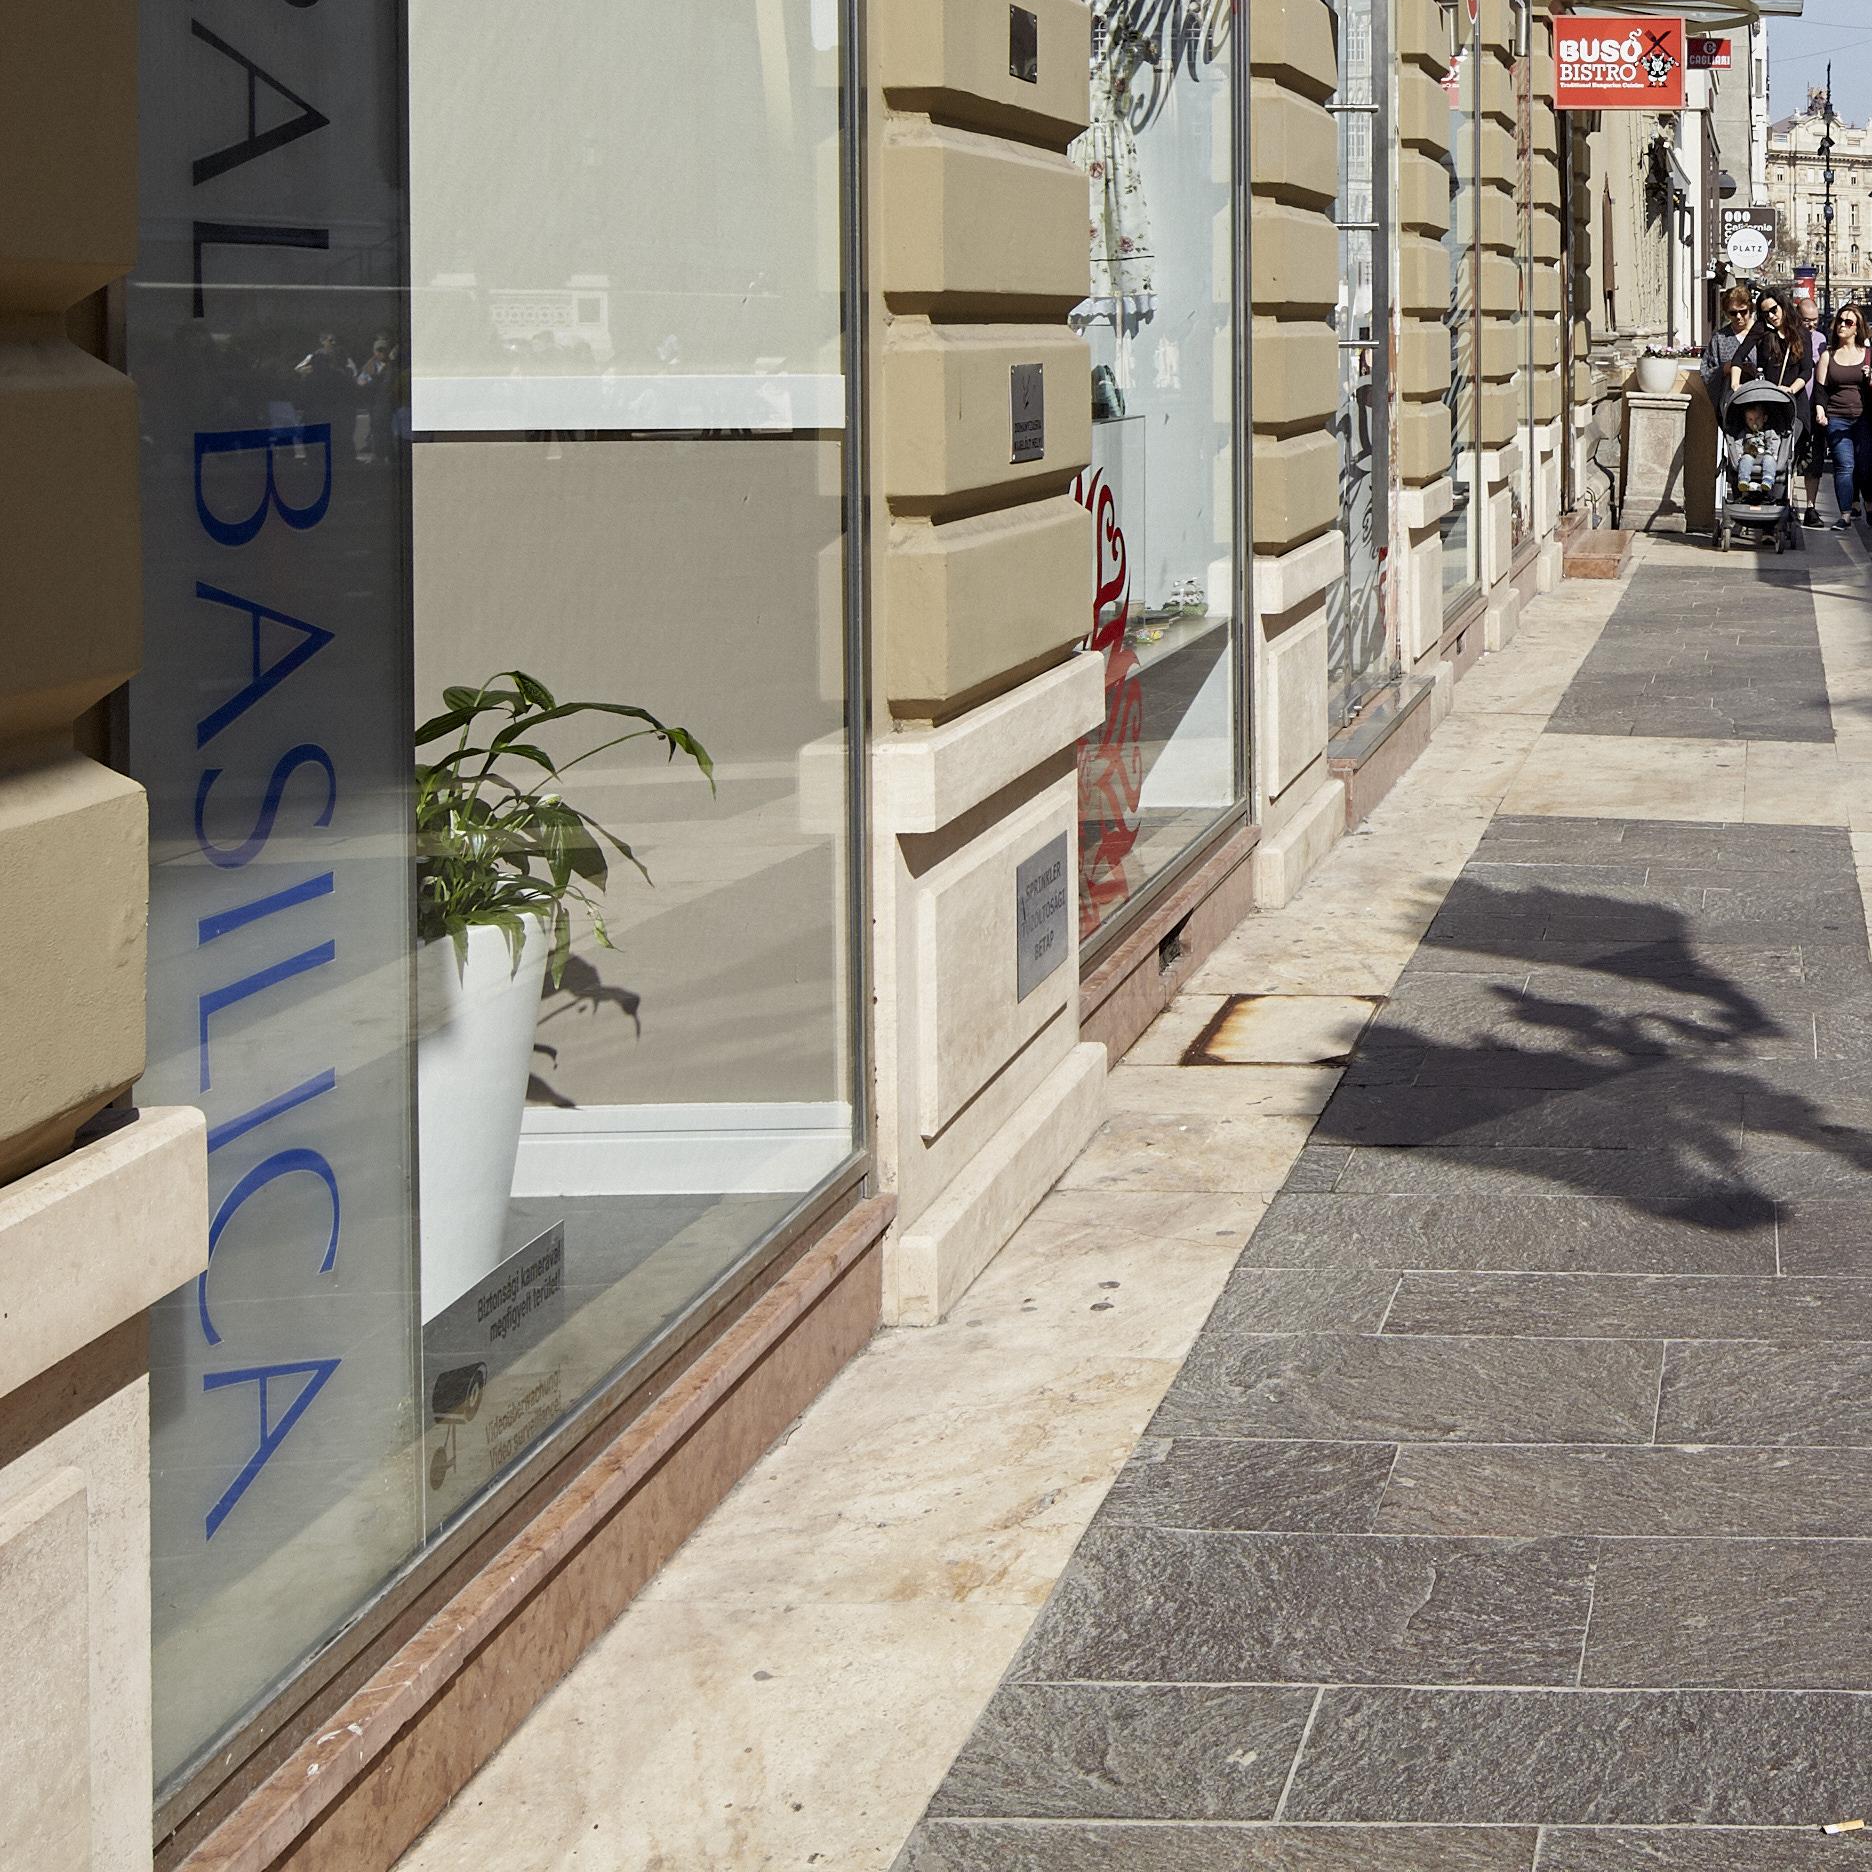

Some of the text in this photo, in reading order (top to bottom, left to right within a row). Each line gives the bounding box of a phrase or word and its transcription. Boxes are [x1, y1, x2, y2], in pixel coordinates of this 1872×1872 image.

[1560, 64, 1637, 81] BISTRO
[193, 423, 341, 1541] BASILICA
[477, 1264, 520, 1322] Biztonsági
